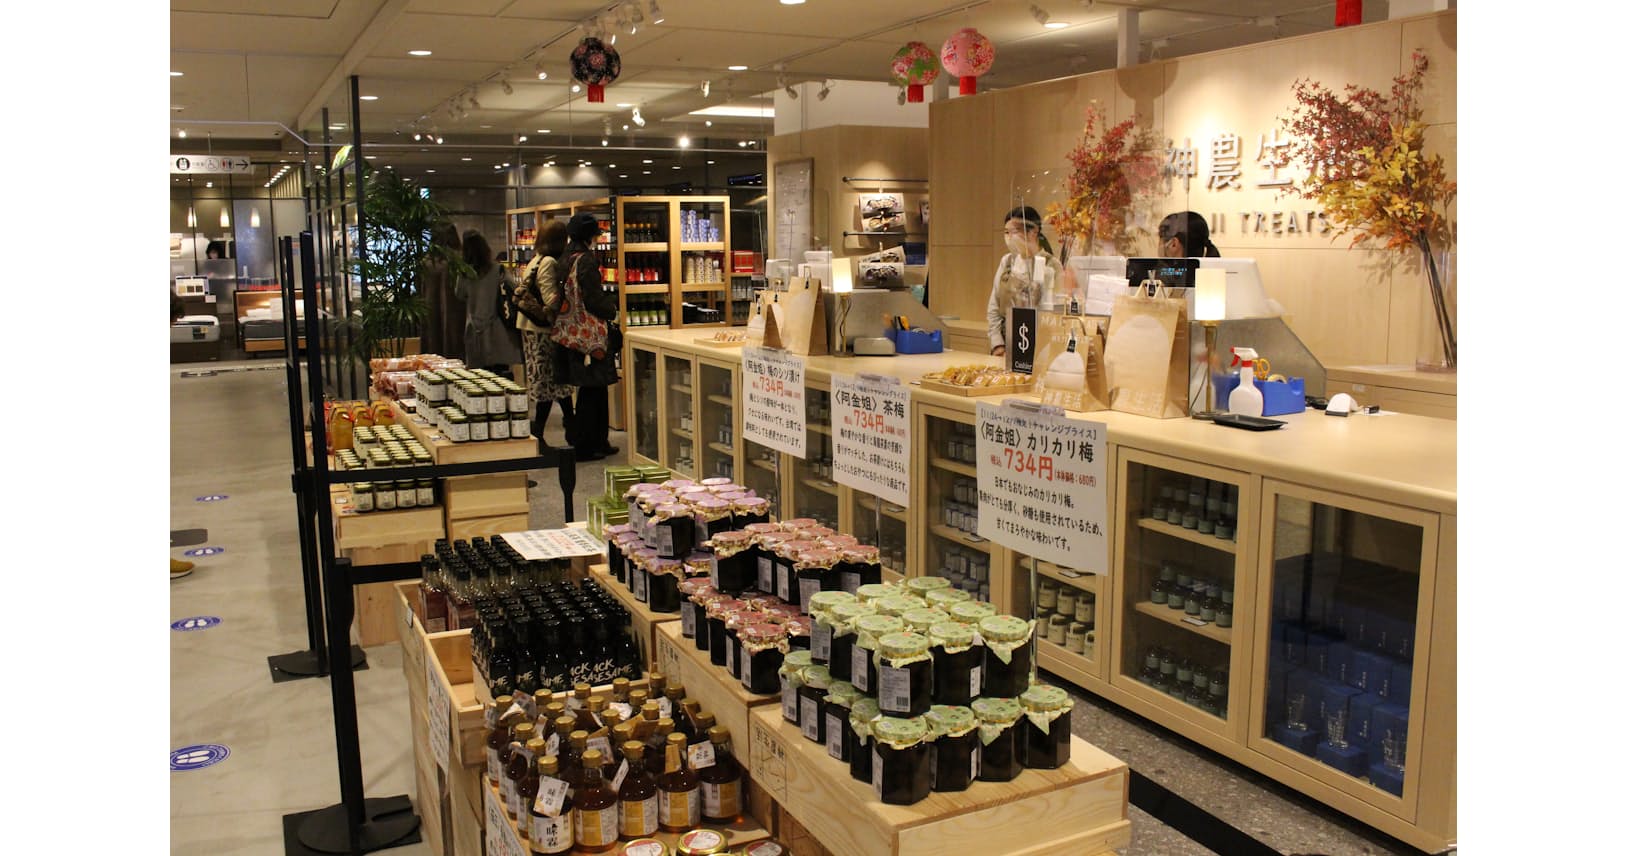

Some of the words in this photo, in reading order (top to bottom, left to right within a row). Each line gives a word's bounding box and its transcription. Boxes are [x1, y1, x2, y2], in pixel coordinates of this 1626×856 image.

[1163, 129, 1340, 197] 神農生
[1240, 210, 1330, 236] TREATS
[759, 375, 784, 398] 734円
[853, 409, 884, 434] 734円
[883, 400, 904, 418] 茶梅
[1027, 432, 1094, 463] カリカリ梅
[1004, 447, 1053, 481] 734円
